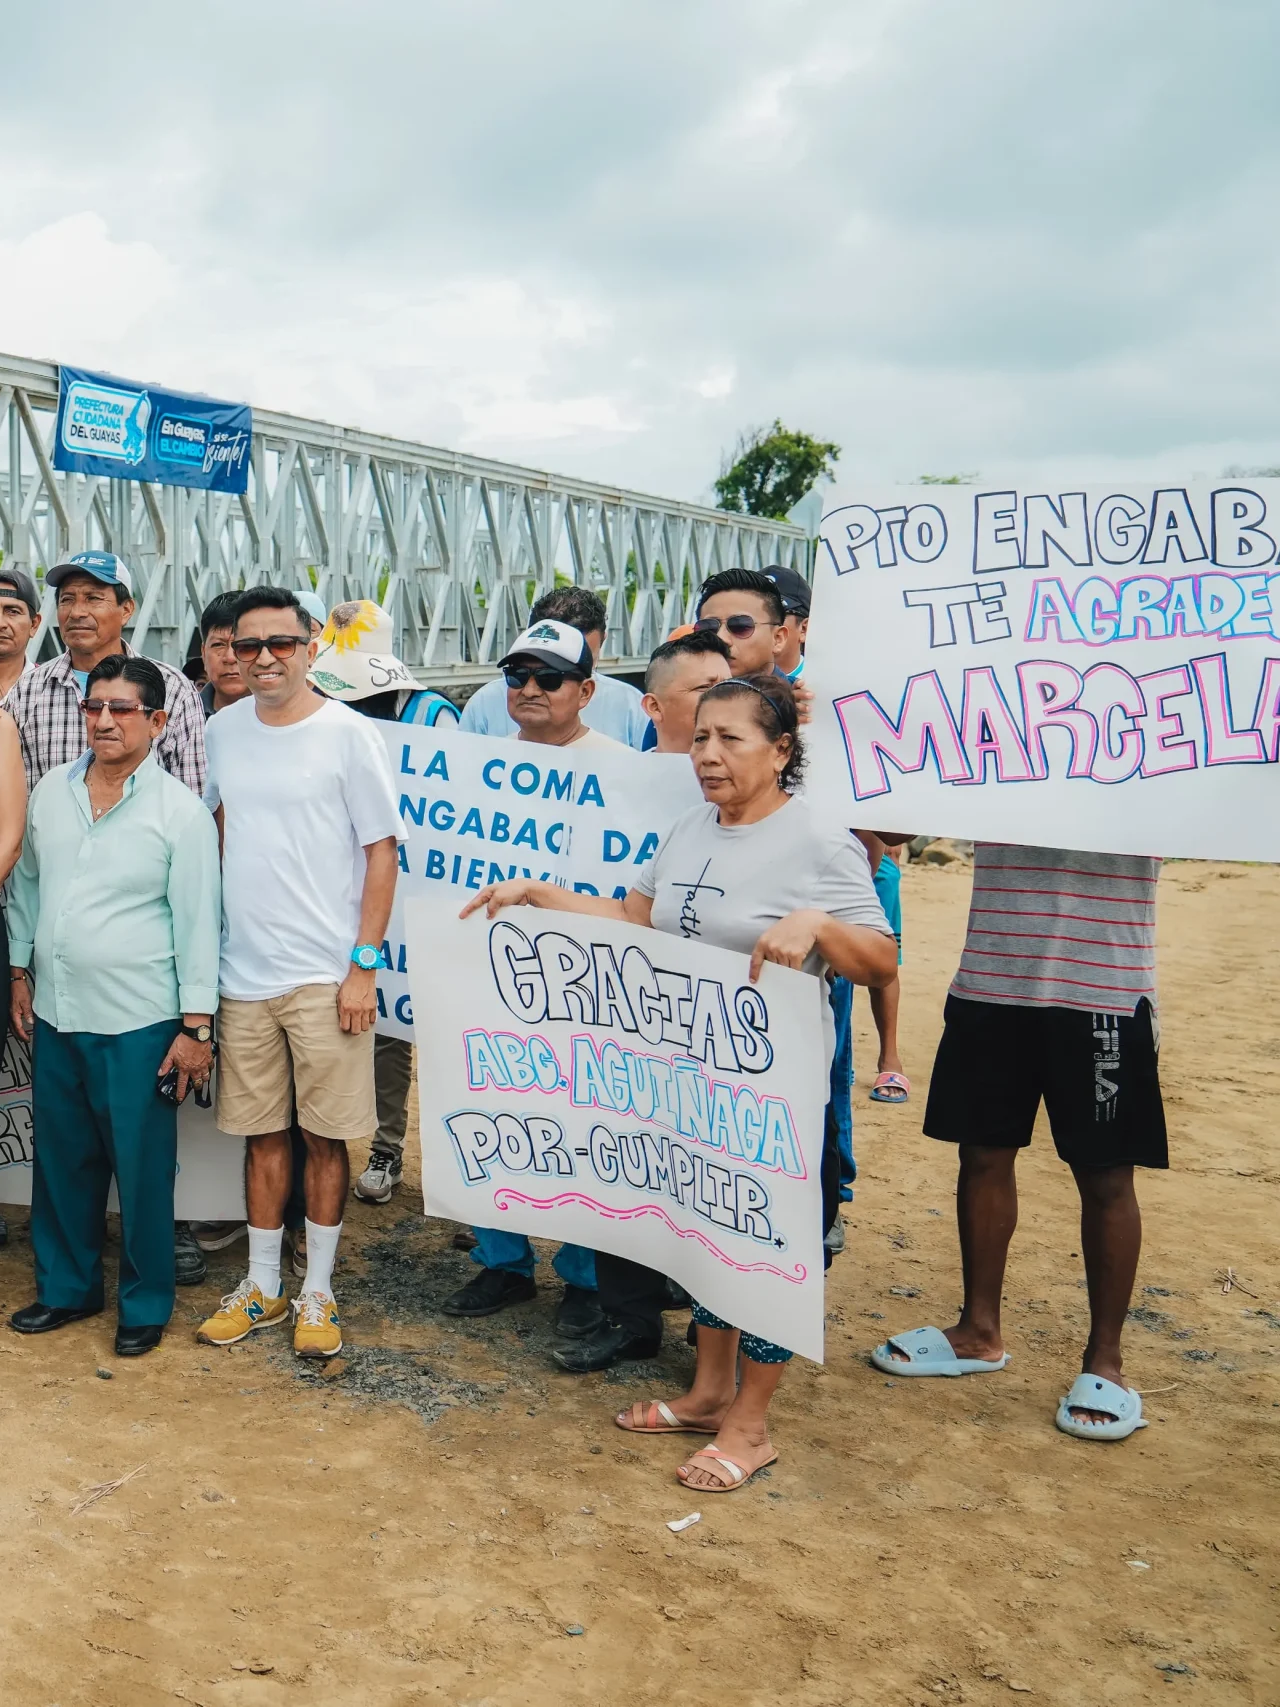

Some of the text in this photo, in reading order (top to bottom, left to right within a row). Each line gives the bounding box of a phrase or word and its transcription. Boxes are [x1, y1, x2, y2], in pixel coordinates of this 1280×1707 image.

[74, 396, 124, 416] PREFECTURA
[161, 420, 174, 435] En
[70, 424, 121, 444] DEL GUAYAS
[160, 438, 205, 458] EL CAMBIO
[972, 488, 1280, 573] ENGAB
[903, 572, 1280, 648] TE AGRADE
[400, 744, 450, 781] LA
[489, 921, 773, 1074] GRACIAS
[1092, 1029, 1120, 1102] FILA
[570, 1033, 808, 1179] AGUIÑAGA
